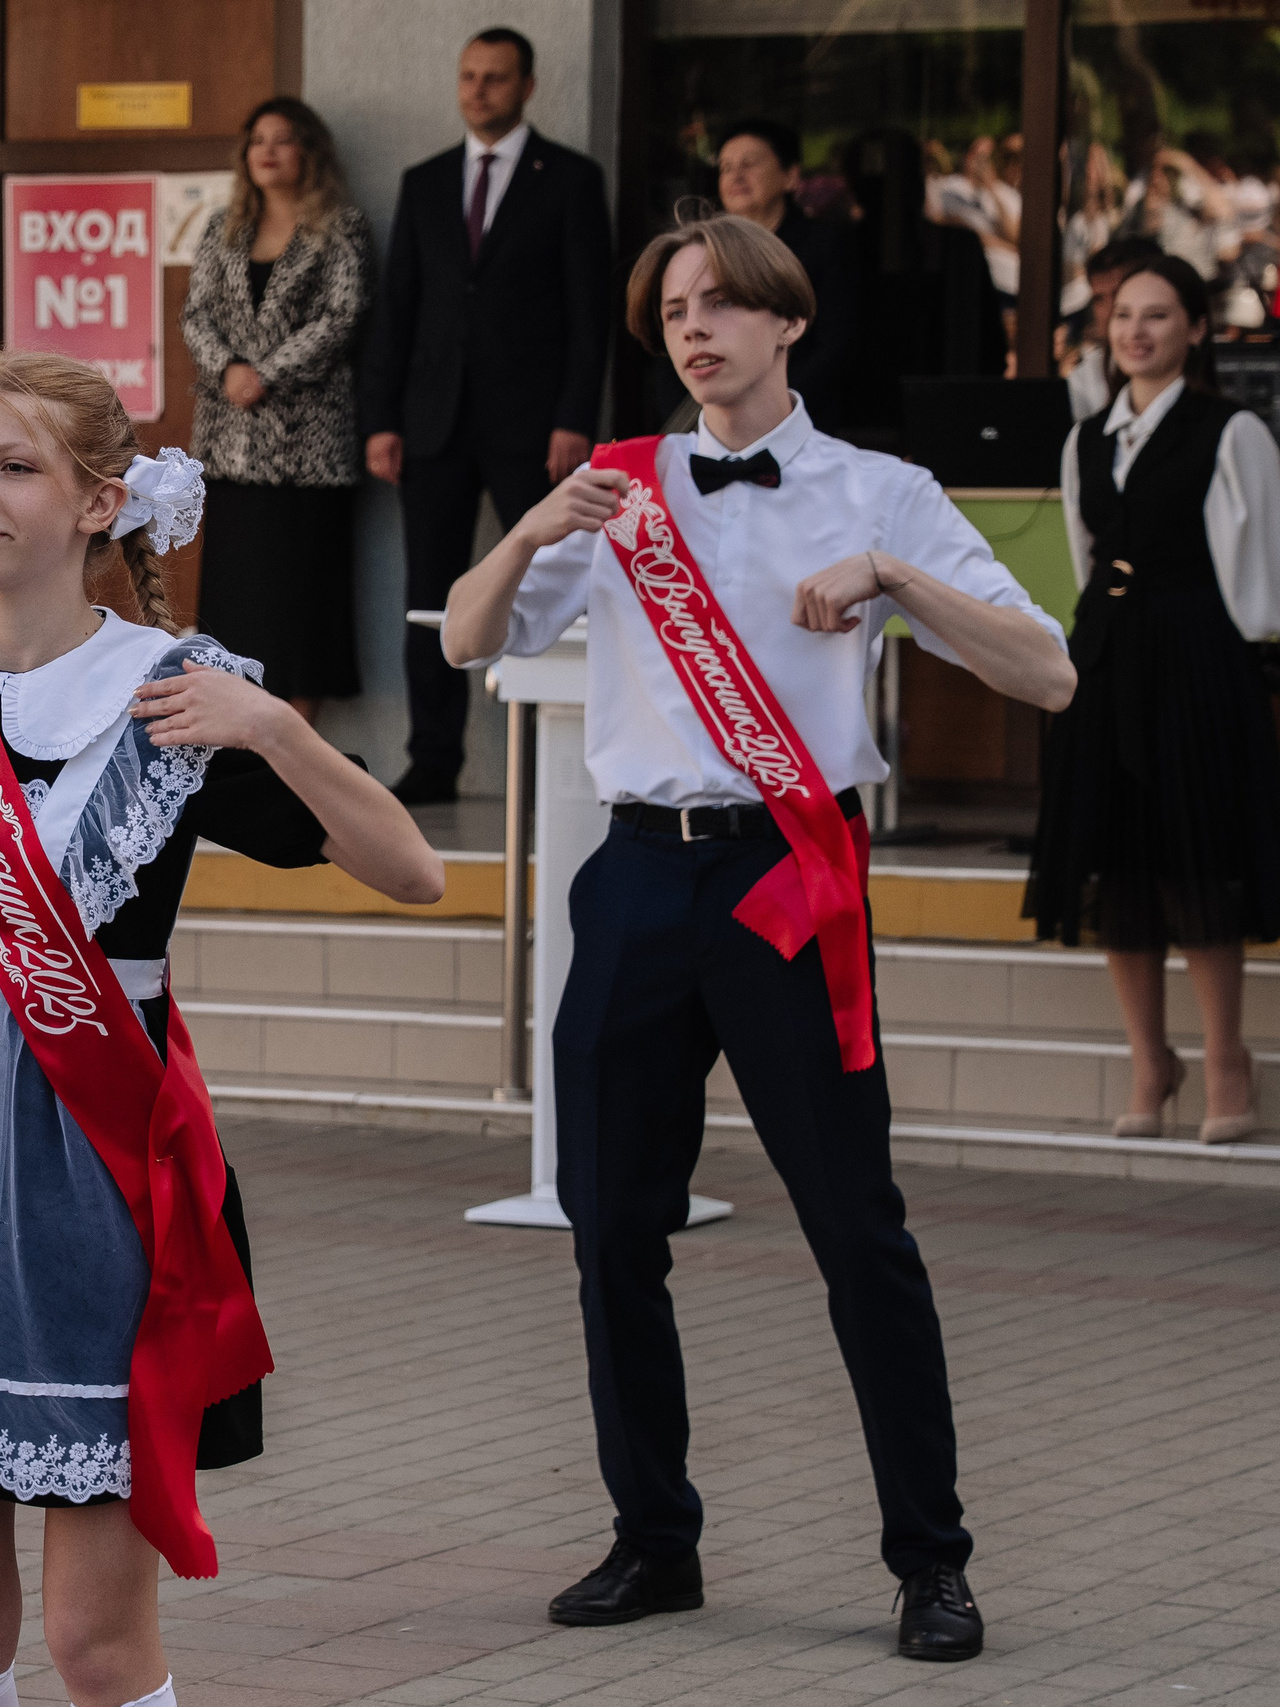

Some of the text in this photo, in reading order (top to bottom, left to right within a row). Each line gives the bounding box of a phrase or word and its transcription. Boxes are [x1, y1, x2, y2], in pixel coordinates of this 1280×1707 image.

[20, 209, 148, 257] ВХОД
[34, 275, 127, 330] №1
[734, 733, 810, 799] 2025
[12, 941, 110, 1037] 2025
